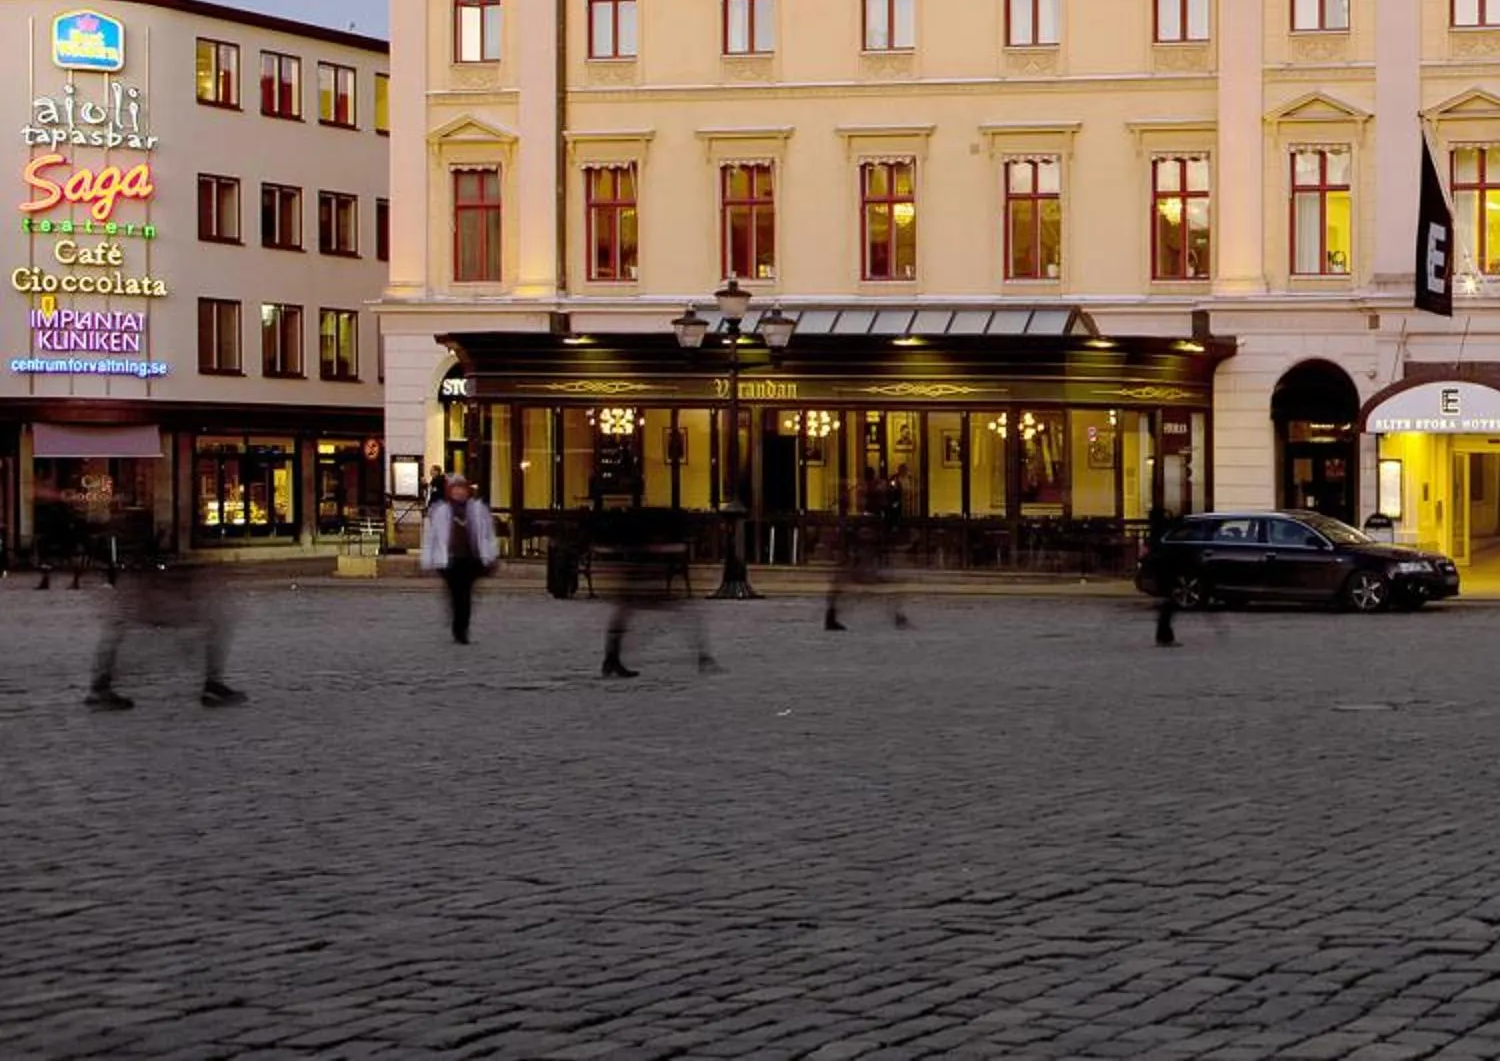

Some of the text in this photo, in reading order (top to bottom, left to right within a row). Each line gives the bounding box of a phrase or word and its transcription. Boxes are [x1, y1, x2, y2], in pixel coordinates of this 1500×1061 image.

[20, 122, 159, 152] tapasbar
[19, 154, 153, 220] Saga
[22, 218, 157, 238] teatern
[55, 240, 123, 265] Café
[11, 267, 168, 297] Cioccolata
[38, 331, 140, 351] KLINIKEN
[713, 379, 798, 399] Vrandan
